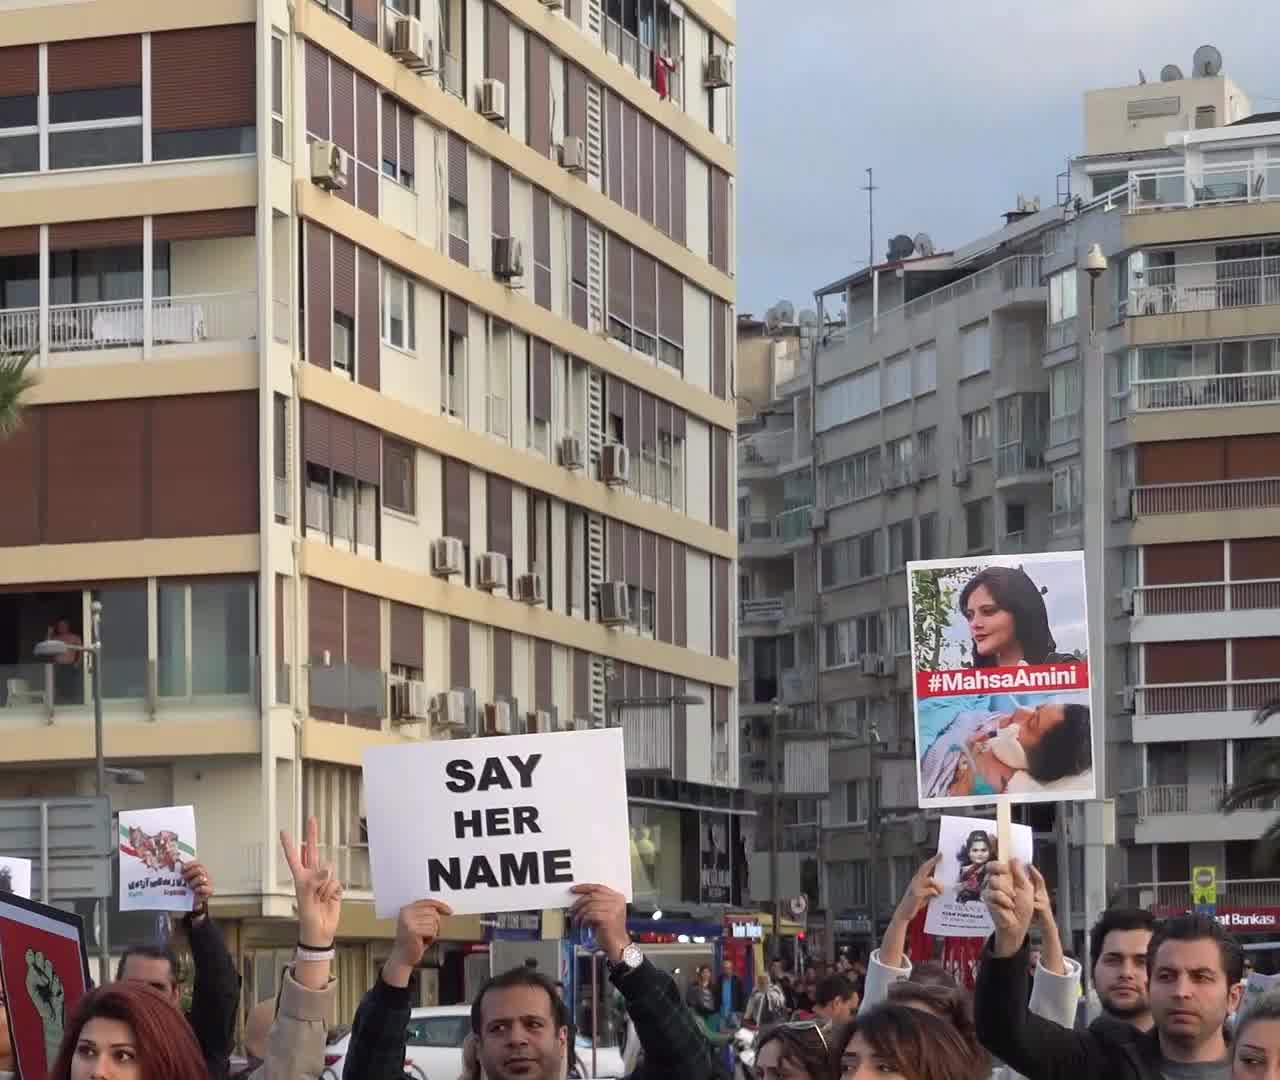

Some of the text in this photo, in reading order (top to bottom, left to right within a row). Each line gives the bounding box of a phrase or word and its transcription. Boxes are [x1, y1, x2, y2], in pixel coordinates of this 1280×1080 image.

[928, 666, 1076, 692] #MahsaAmini
[445, 754, 542, 793] SAY
[454, 806, 542, 838] HER
[428, 849, 574, 892] NAME
[1232, 914, 1275, 925] Bankası
